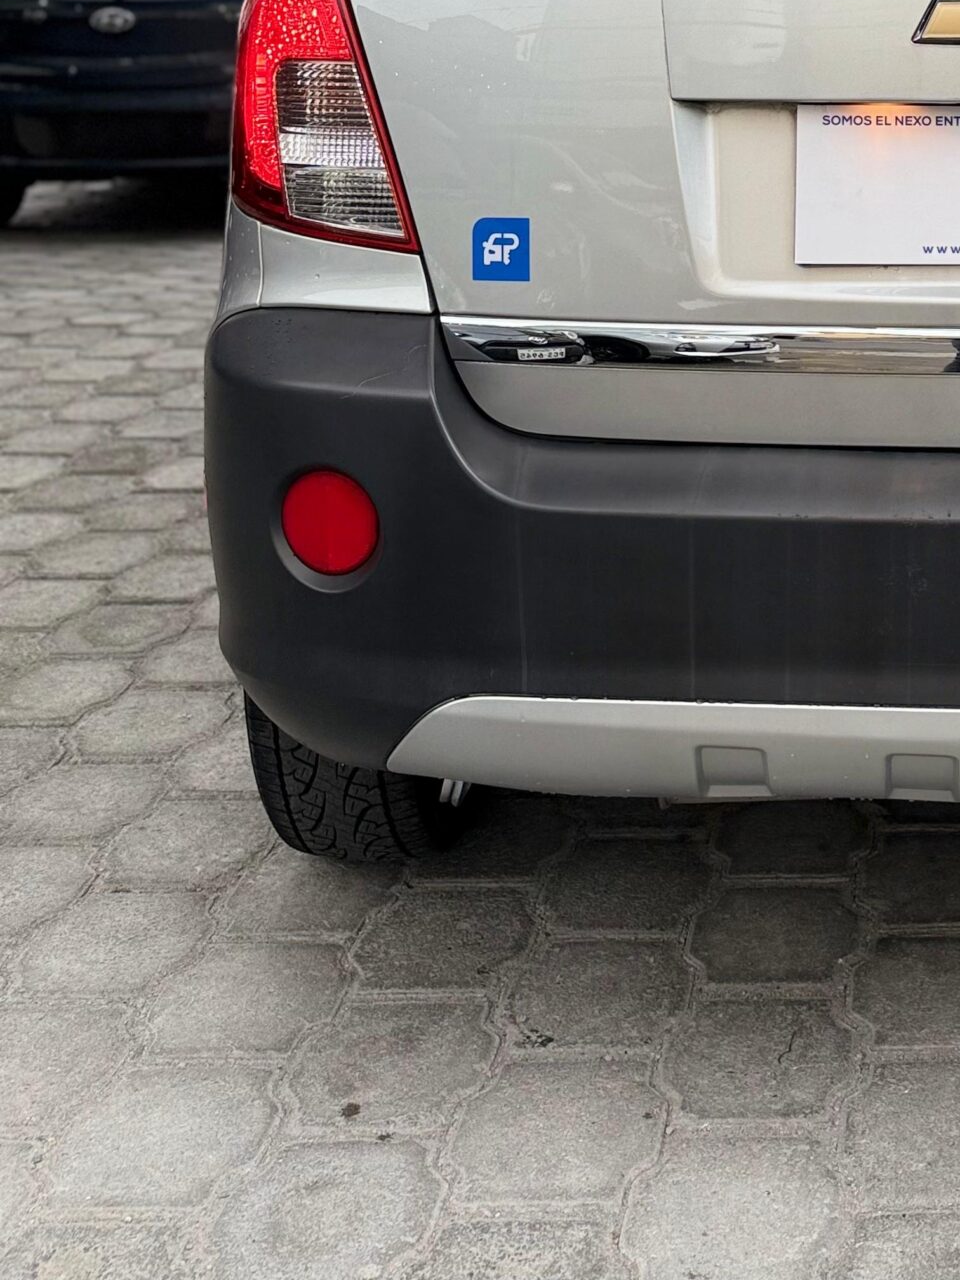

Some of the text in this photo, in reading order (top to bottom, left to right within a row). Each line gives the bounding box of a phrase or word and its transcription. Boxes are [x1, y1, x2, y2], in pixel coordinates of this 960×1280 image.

[822, 114, 873, 128] SOMOS
[875, 114, 892, 128] EL
[894, 114, 932, 128] NEXO
